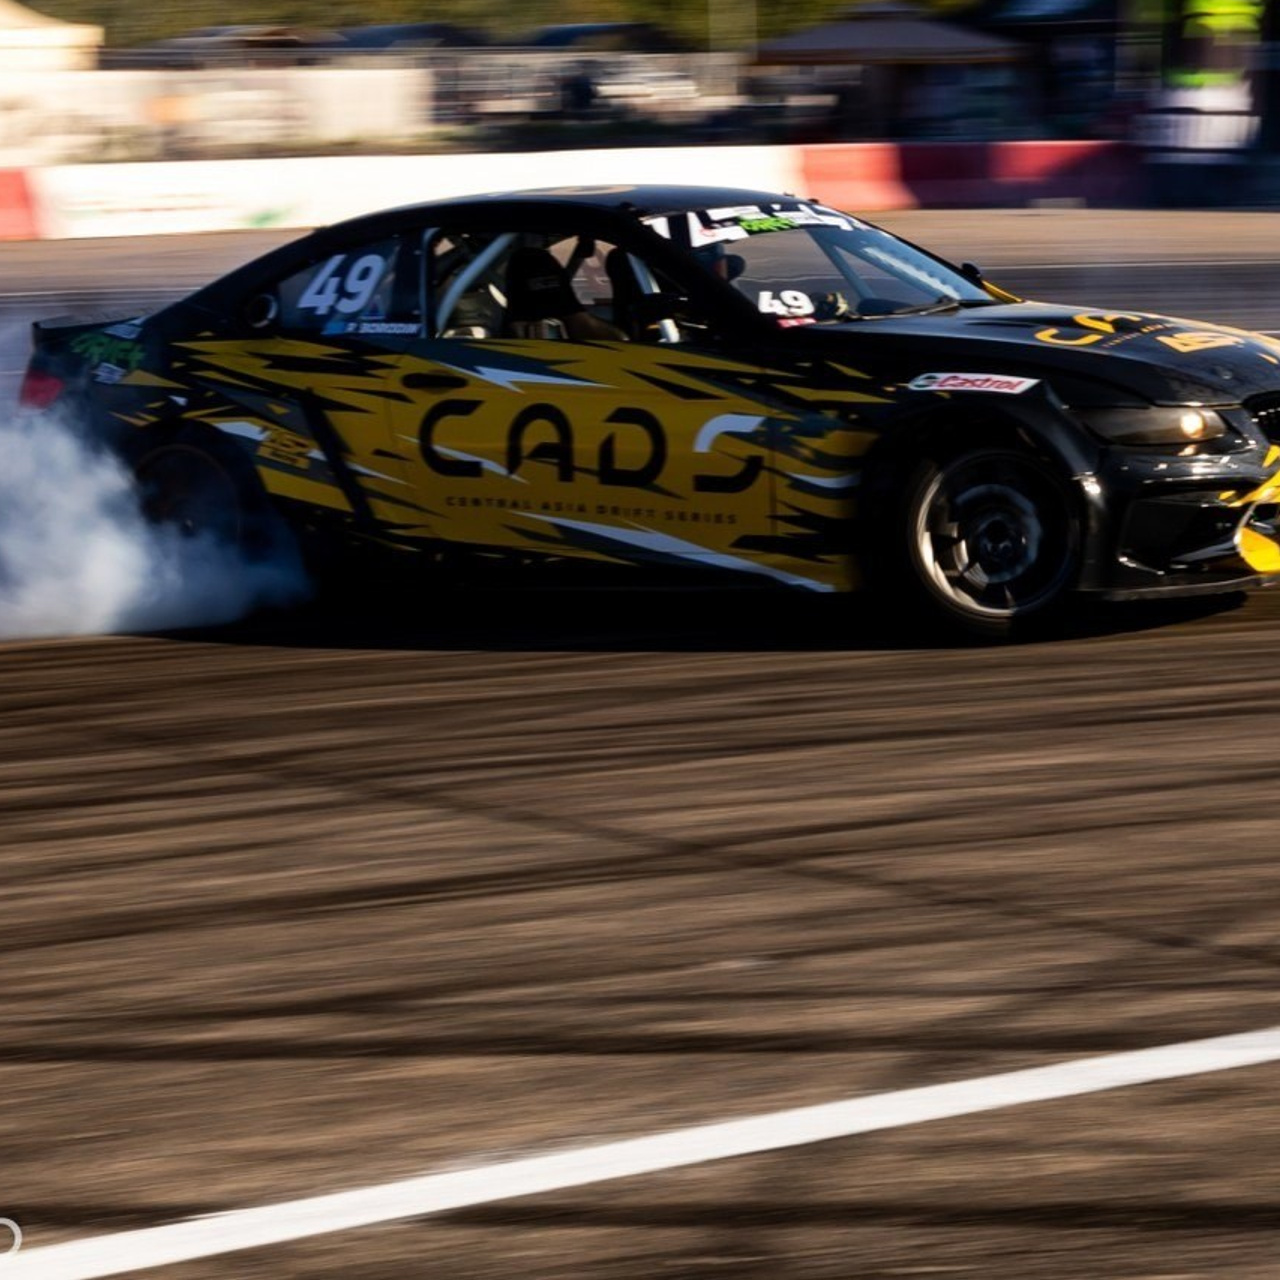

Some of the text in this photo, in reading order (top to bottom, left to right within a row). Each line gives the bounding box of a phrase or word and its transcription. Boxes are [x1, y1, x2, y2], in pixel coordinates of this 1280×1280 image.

[297, 253, 386, 314] 49
[759, 290, 815, 316] 49
[419, 399, 767, 493] CADS
[664, 510, 738, 524] SERIES
